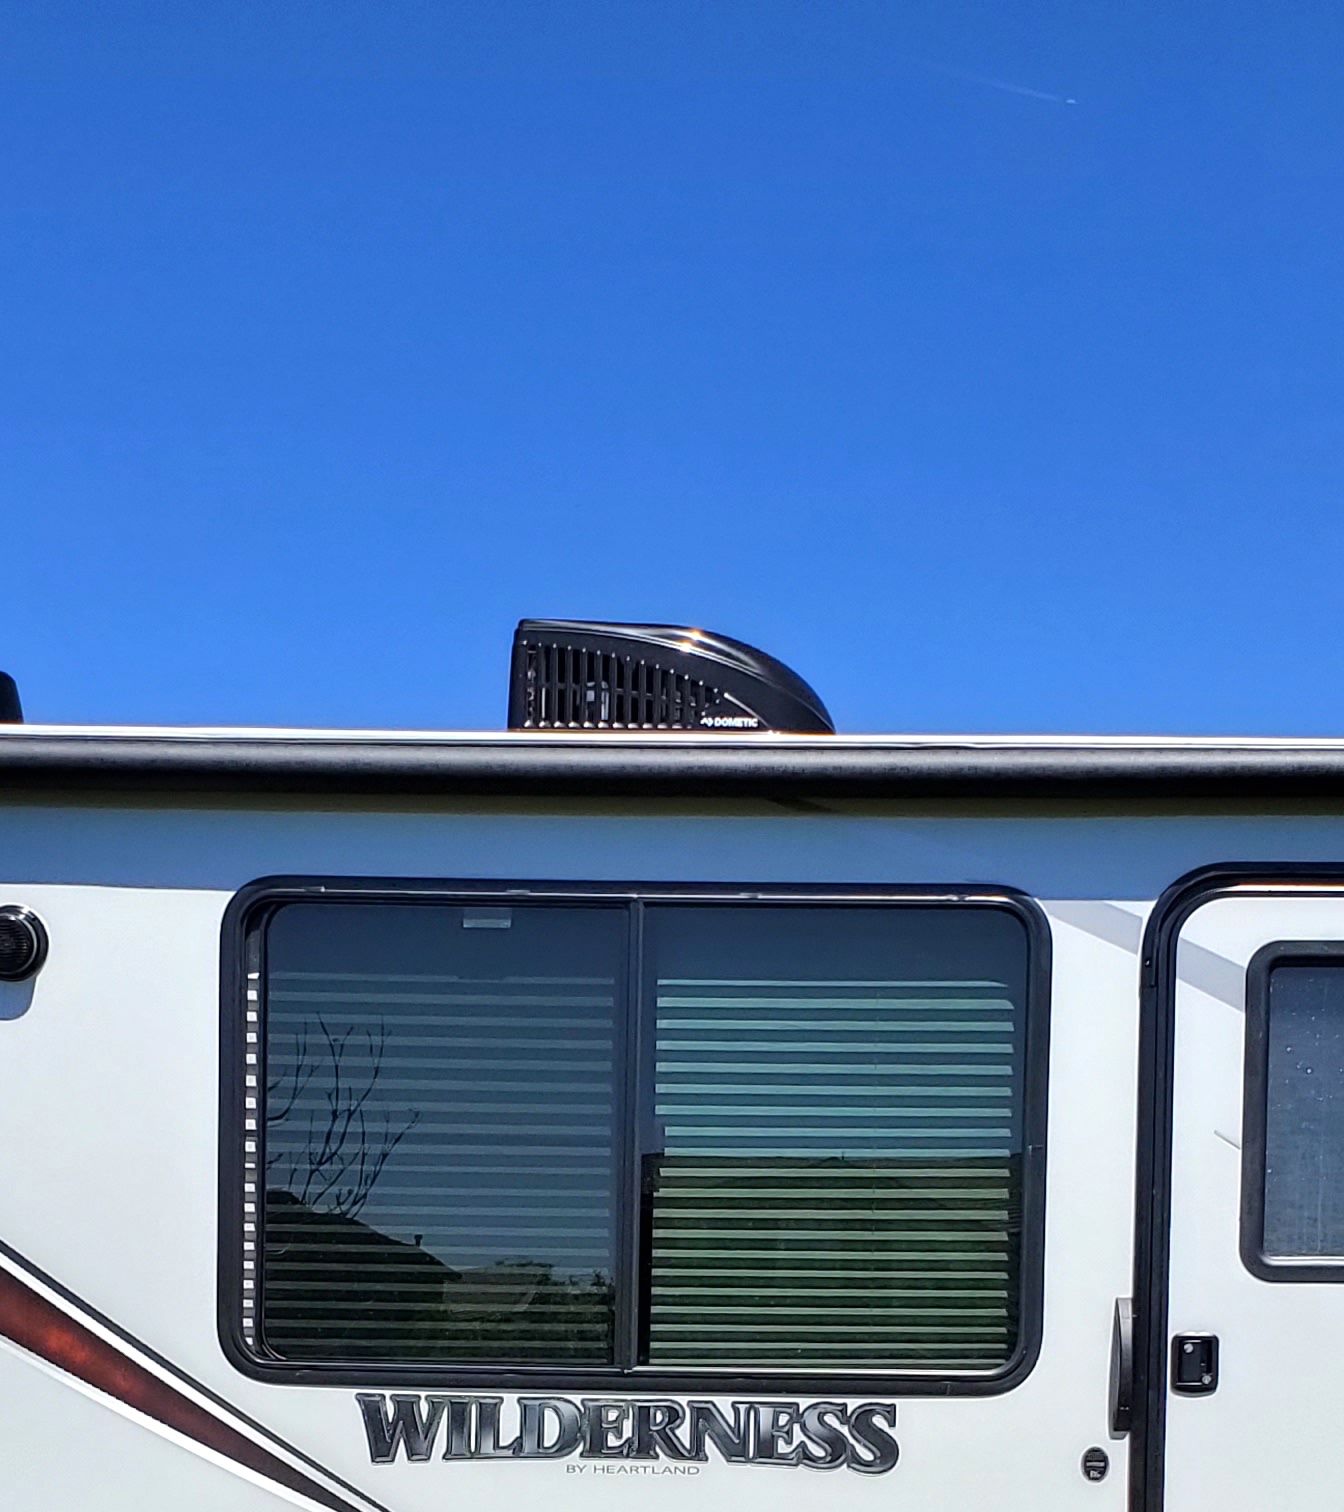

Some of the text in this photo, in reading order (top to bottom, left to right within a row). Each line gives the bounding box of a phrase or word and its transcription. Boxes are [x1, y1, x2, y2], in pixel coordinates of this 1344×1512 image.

[714, 717, 759, 728] DOMETIC
[355, 1392, 900, 1475] WILDERNESS
[565, 1464, 700, 1475] BY HEARTLAND
